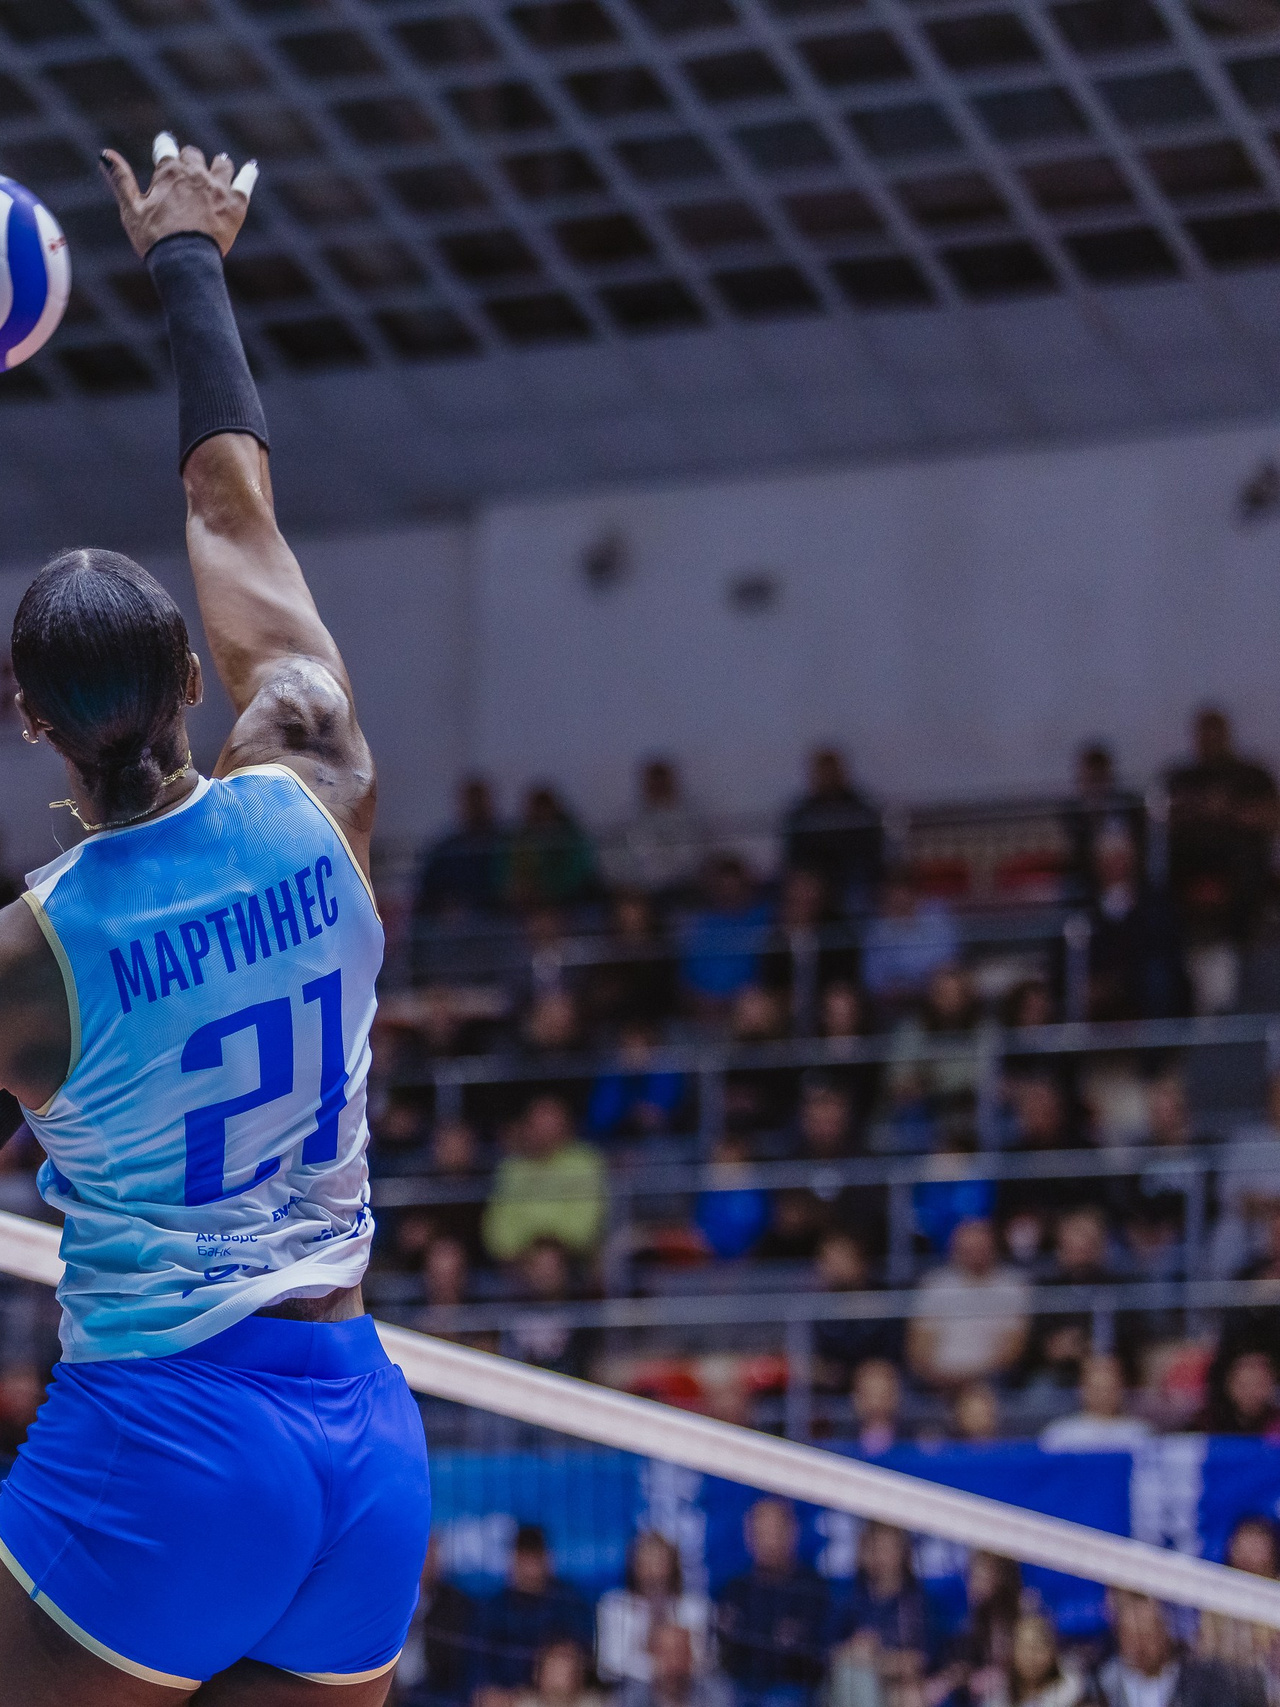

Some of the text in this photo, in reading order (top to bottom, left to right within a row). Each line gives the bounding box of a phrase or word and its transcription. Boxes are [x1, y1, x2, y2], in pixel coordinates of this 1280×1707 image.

[109, 855, 339, 1014] МАРТИНЕС
[180, 968, 349, 1207] 21
[197, 1245, 232, 1257] Банк
